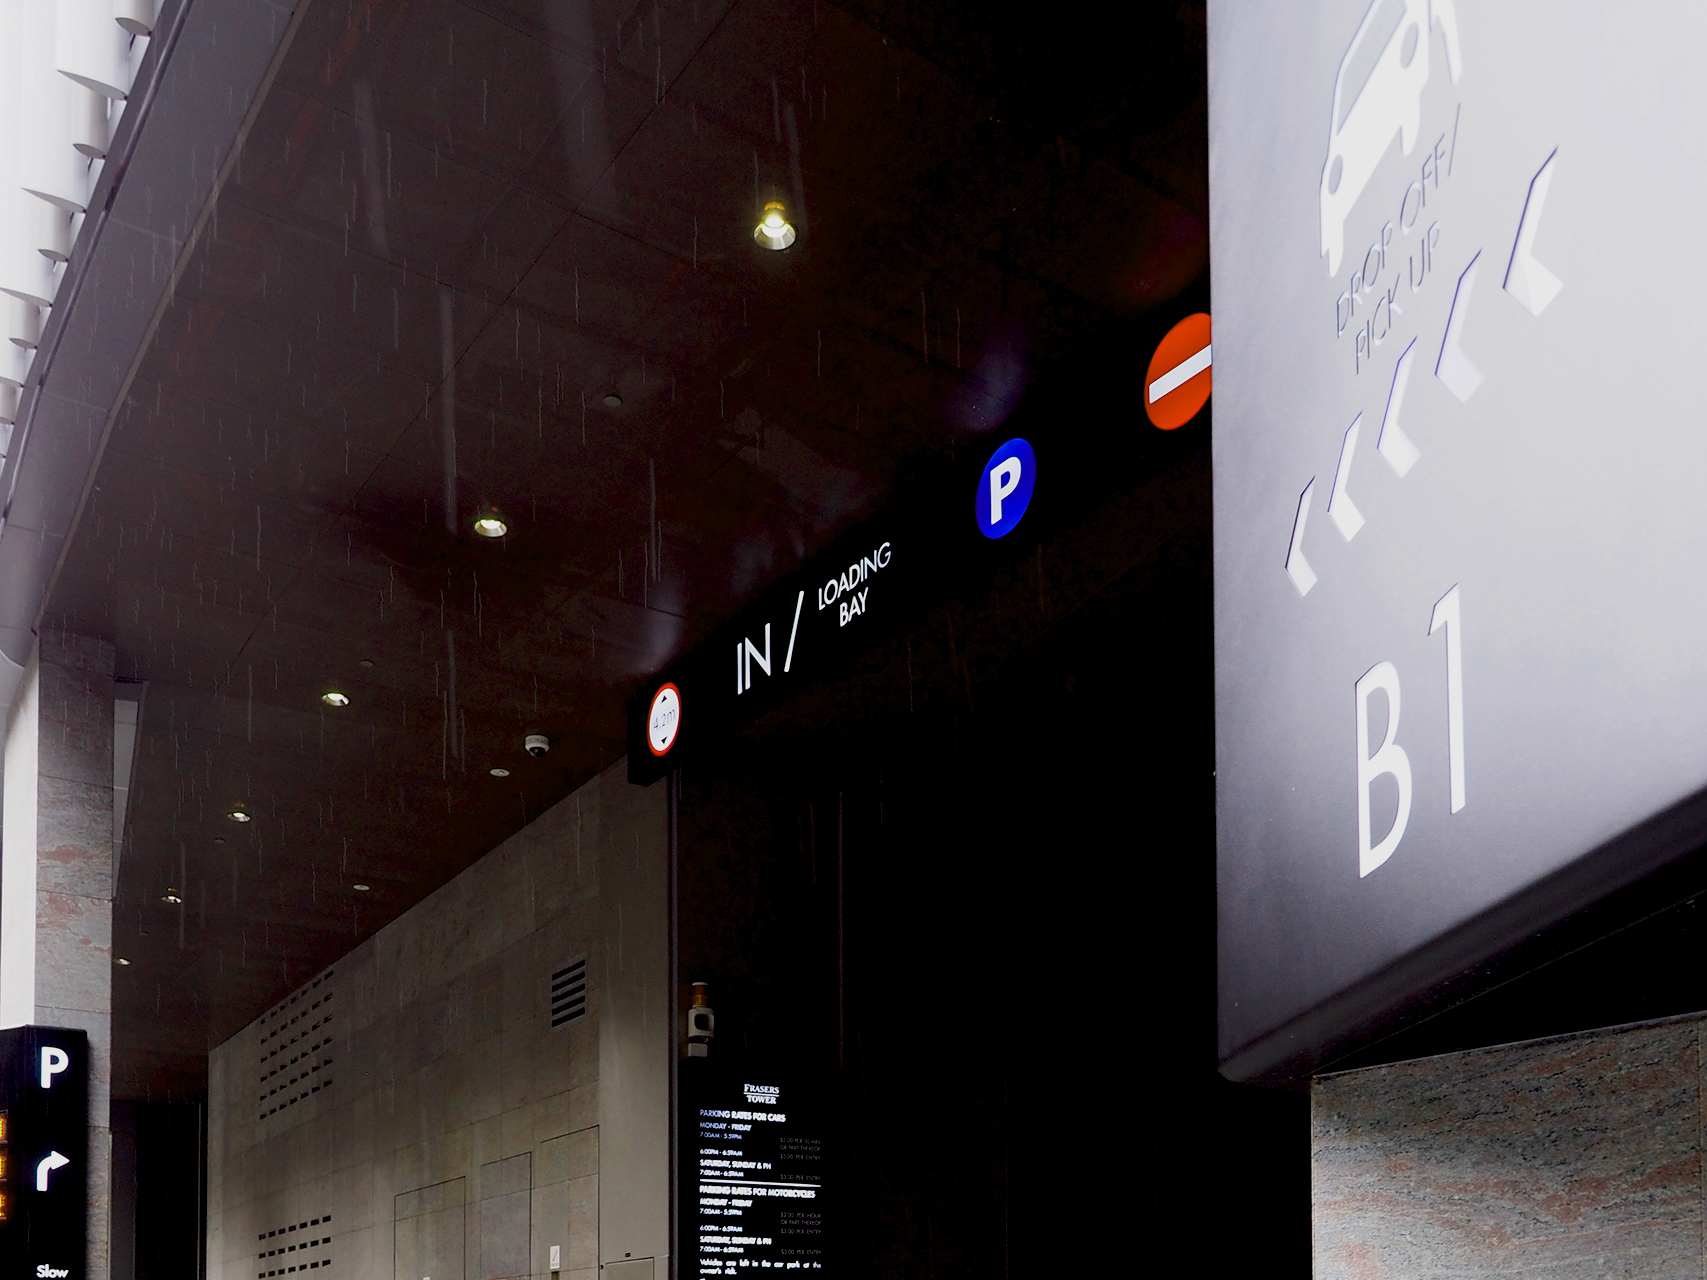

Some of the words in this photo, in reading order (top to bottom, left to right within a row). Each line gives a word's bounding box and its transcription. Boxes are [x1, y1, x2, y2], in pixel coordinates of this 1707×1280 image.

[1337, 220, 1393, 339] DROP
[1356, 273, 1402, 375] PICK
[1410, 220, 1440, 294] UP
[990, 456, 1022, 525] P
[818, 541, 892, 611] LOADING
[839, 586, 869, 627] BAY
[737, 623, 771, 695] IN
[653, 708, 676, 731] 4.2m
[1355, 583, 1466, 879] B1
[40, 1046, 69, 1089] P
[744, 1084, 779, 1093] FRASERS
[746, 1095, 776, 1104] TOWER
[700, 1109, 730, 1118] PARKING
[732, 1111, 751, 1119] RATES
[753, 1112, 767, 1121] FOR
[768, 1113, 786, 1122] CARS
[732, 1160, 756, 1168] SUNDAY
[700, 1185, 730, 1194] PARKING
[732, 1187, 752, 1196] RATES
[753, 1188, 767, 1196] FOR
[768, 1189, 815, 1198] MOTORCYCLES
[700, 1198, 728, 1206] MONDAY
[732, 1199, 753, 1207] FRIDAY
[732, 1236, 756, 1244] SUNDAY
[36, 1264, 69, 1279] Slow
[739, 1259, 750, 1267] left
[787, 1261, 800, 1269] park
